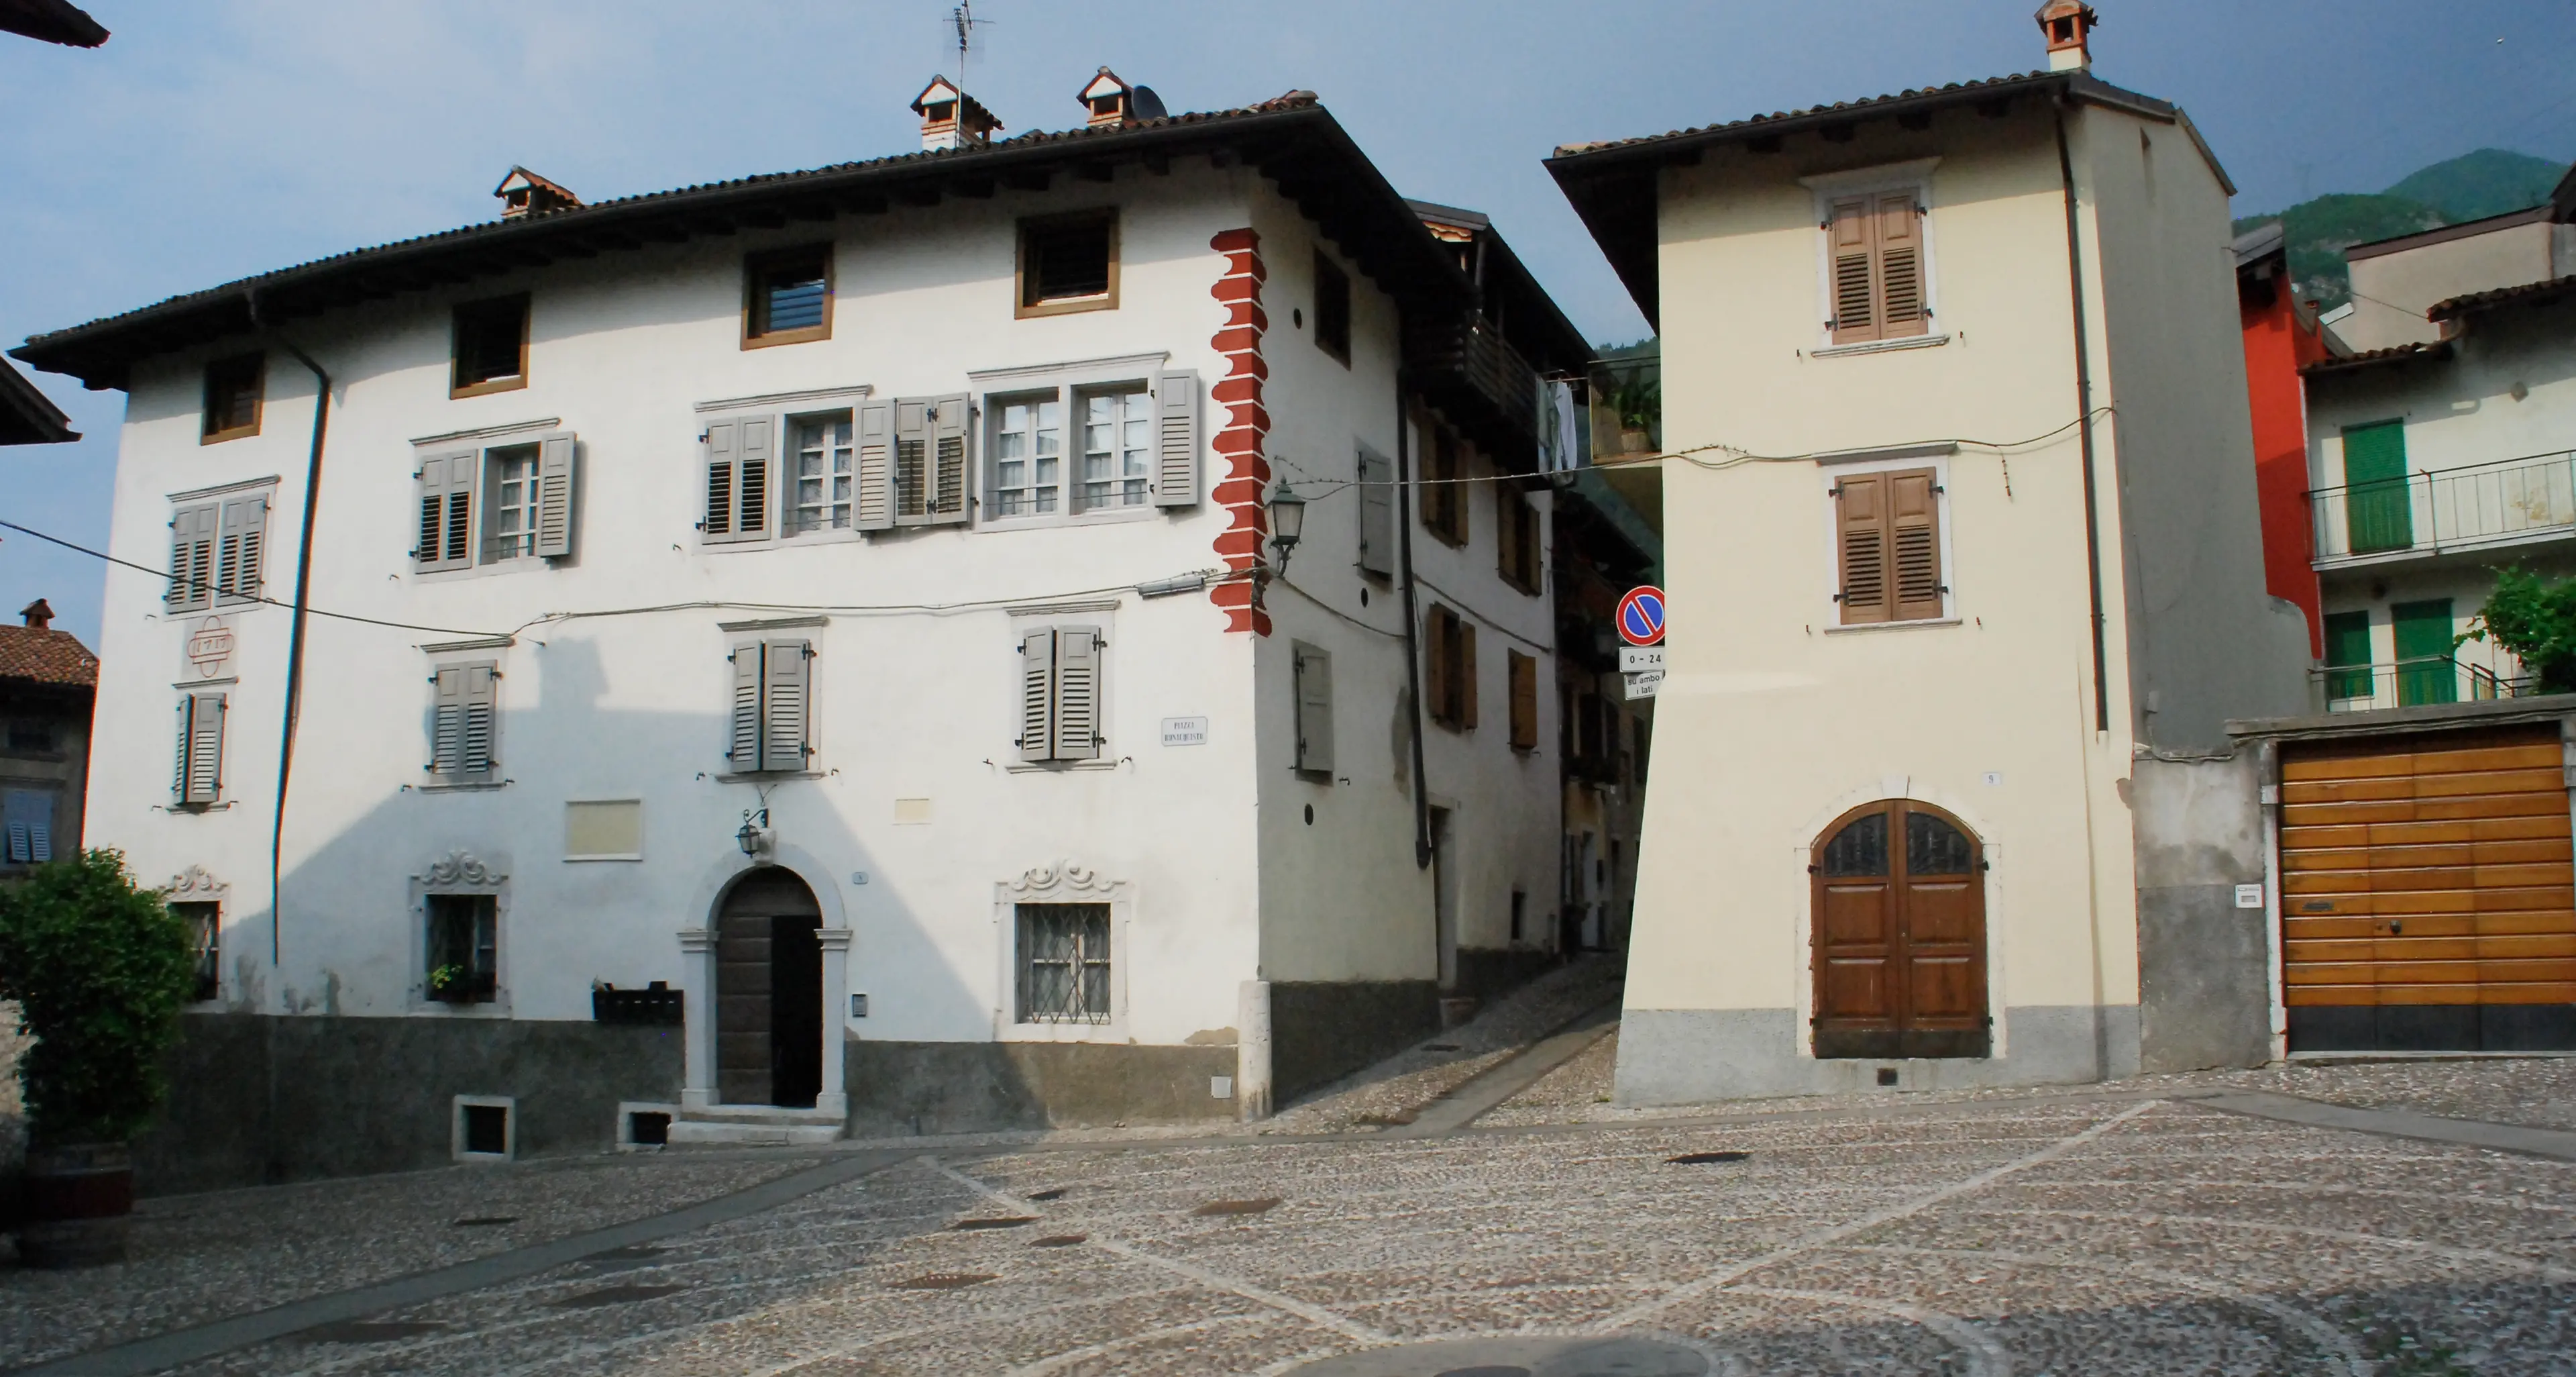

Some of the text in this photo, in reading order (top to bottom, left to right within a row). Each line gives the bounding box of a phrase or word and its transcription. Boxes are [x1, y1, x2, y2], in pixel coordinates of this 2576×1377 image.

[1629, 655, 1635, 663] 0
[1650, 654, 1661, 663] 24
[1627, 674, 1660, 686] su ambo
[1641, 686, 1653, 695] lati
[1174, 721, 1194, 729] PIAZZA
[1988, 774, 1994, 784] 9
